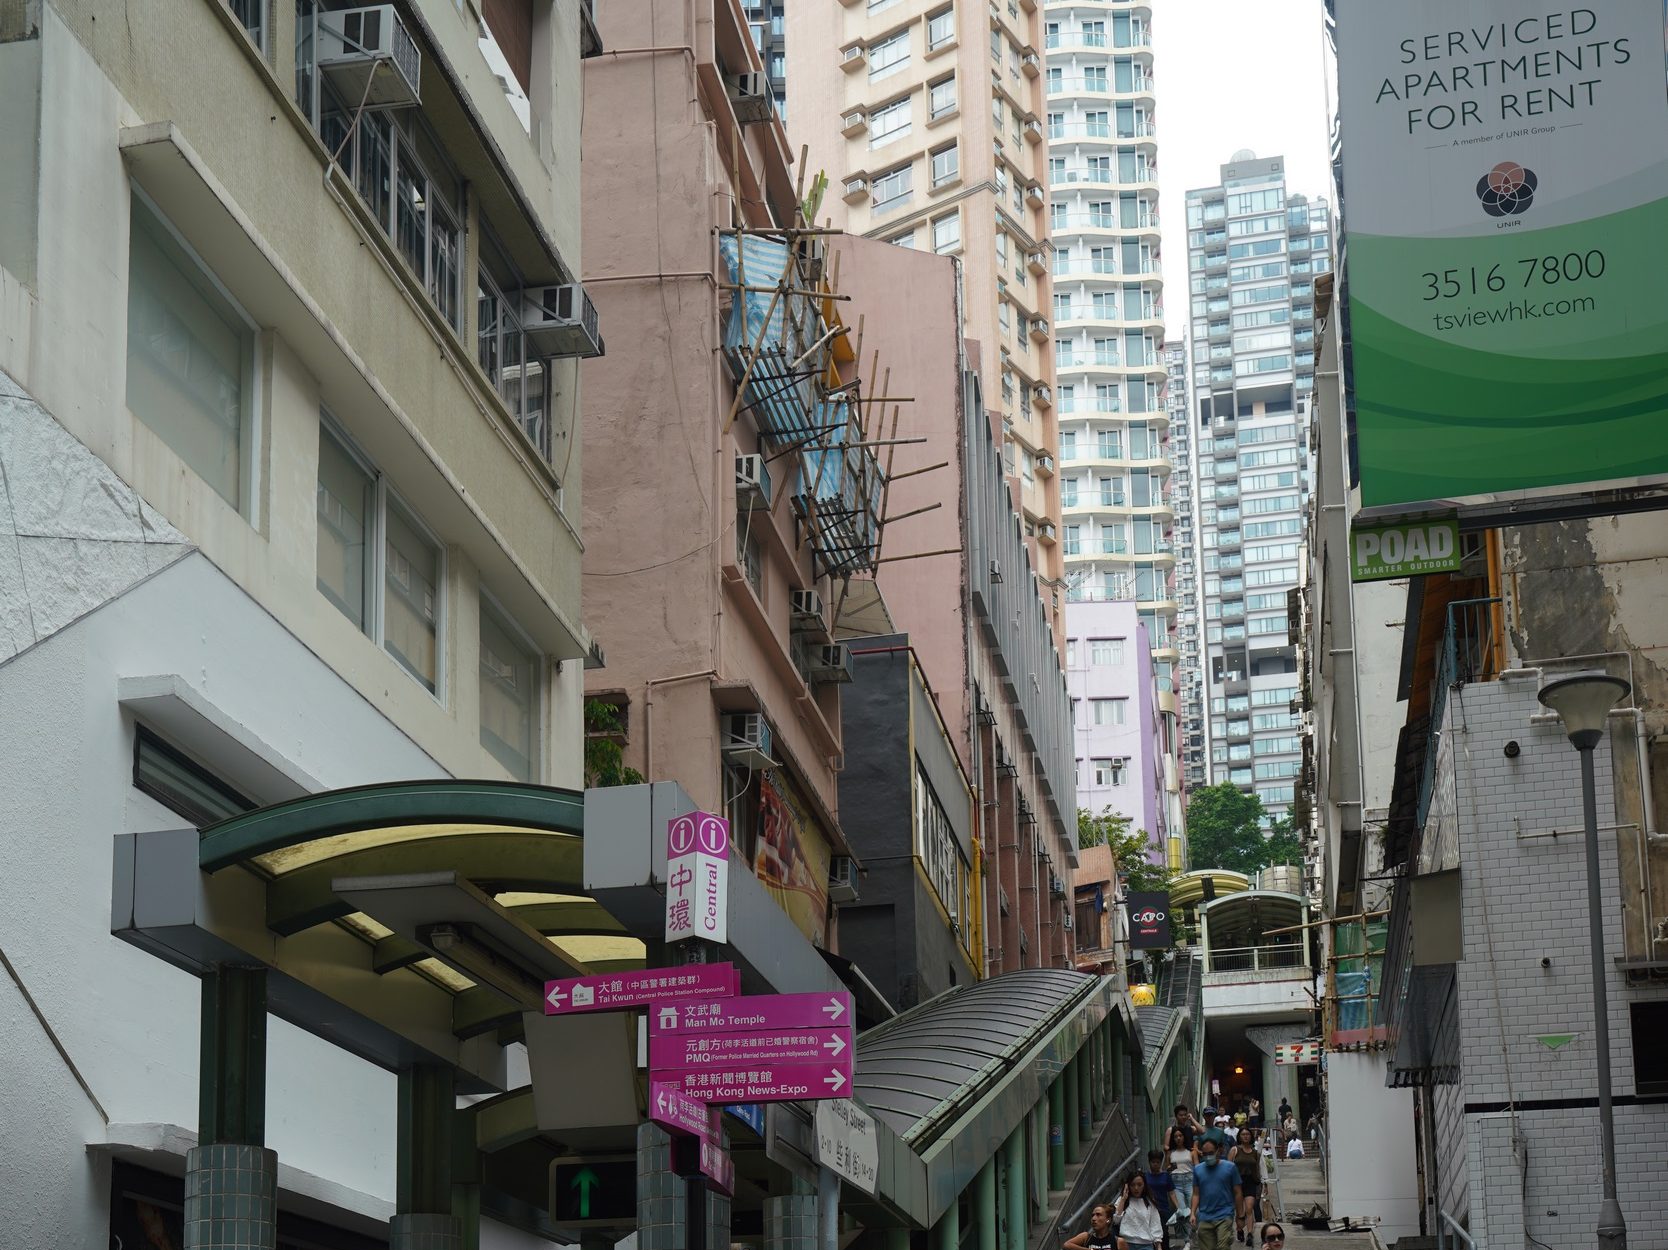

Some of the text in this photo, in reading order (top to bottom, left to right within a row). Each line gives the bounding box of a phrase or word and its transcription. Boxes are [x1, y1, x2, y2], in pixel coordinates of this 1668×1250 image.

[1400, 9, 1597, 64] SERVICED
[1375, 38, 1631, 104] APARTMENTS
[1407, 79, 1602, 135] FOR RENT
[1452, 125, 1556, 147] A member of UNIR Group
[1496, 220, 1521, 229] UNIR
[1421, 249, 1605, 301] 3516 7800
[1433, 296, 1595, 330] tsviewhk.com
[1356, 525, 1454, 567] POAD
[1358, 559, 1454, 576] SMARTER OUTDOOR
[669, 863, 692, 932] 中環
[704, 862, 718, 931] Central
[598, 980, 623, 994] 大館
[598, 995, 611, 1004] Tai
[612, 993, 634, 1002] Kwun
[635, 991, 656, 1001] (Central
[657, 989, 674, 998] Police
[674, 988, 693, 996] Station
[694, 985, 726, 995] Compound)
[684, 1003, 721, 1018] 文武廟
[685, 1014, 766, 1028] Man Mo Temple
[685, 1052, 710, 1064] PMQ
[728, 1052, 742, 1060] Police
[785, 1049, 809, 1058] Hollywood
[684, 1070, 773, 1086] 香港新聞博覽館
[685, 1084, 808, 1099] Hong Kong News-Expo
[832, 1099, 866, 1135] Shelley Street
